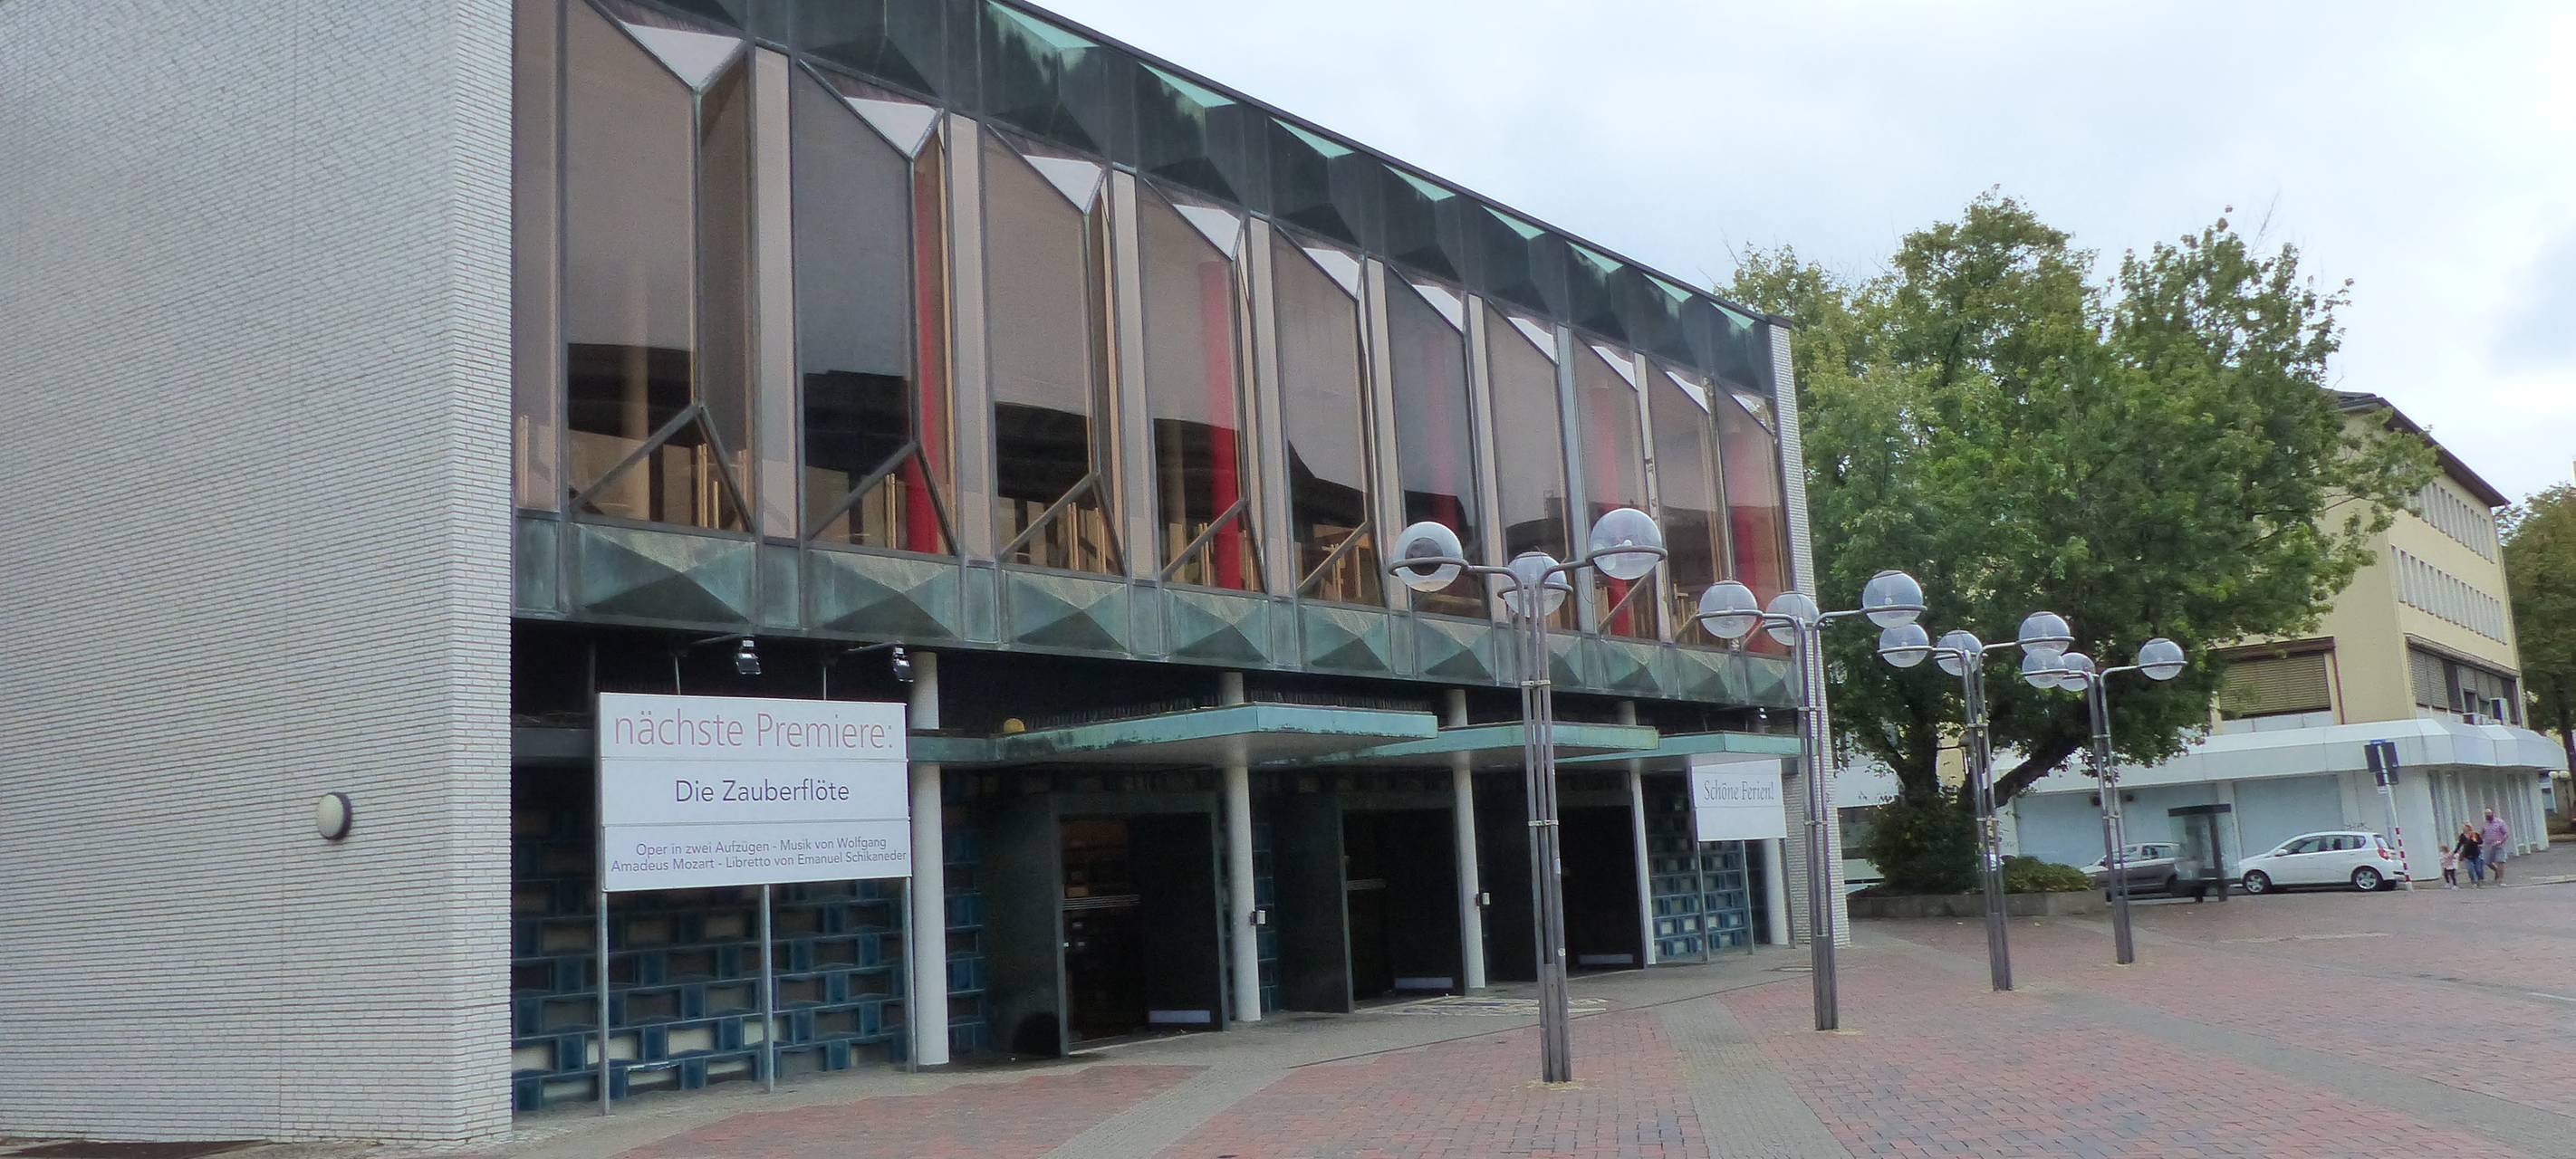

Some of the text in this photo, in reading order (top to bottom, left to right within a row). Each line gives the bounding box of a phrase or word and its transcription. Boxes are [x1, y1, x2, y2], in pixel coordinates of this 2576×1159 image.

[615, 708, 894, 750] nächste Premiere:
[676, 778, 850, 802] Die Zauberflöte
[1703, 780, 1775, 800] Schöne Ferien!
[636, 842, 668, 858] Oper
[671, 843, 682, 855] in
[685, 842, 712, 855] zwei
[715, 839, 770, 856] Aufzügen
[779, 838, 812, 851] Musik
[814, 840, 834, 850] von
[836, 836, 887, 850] Wolfgang
[610, 858, 669, 873] Amadeus
[673, 857, 715, 871] Mozart
[726, 857, 771, 869] Libretto
[774, 857, 794, 867] von
[797, 852, 843, 866] Emanuel
[845, 848, 908, 863] Schikaneder
